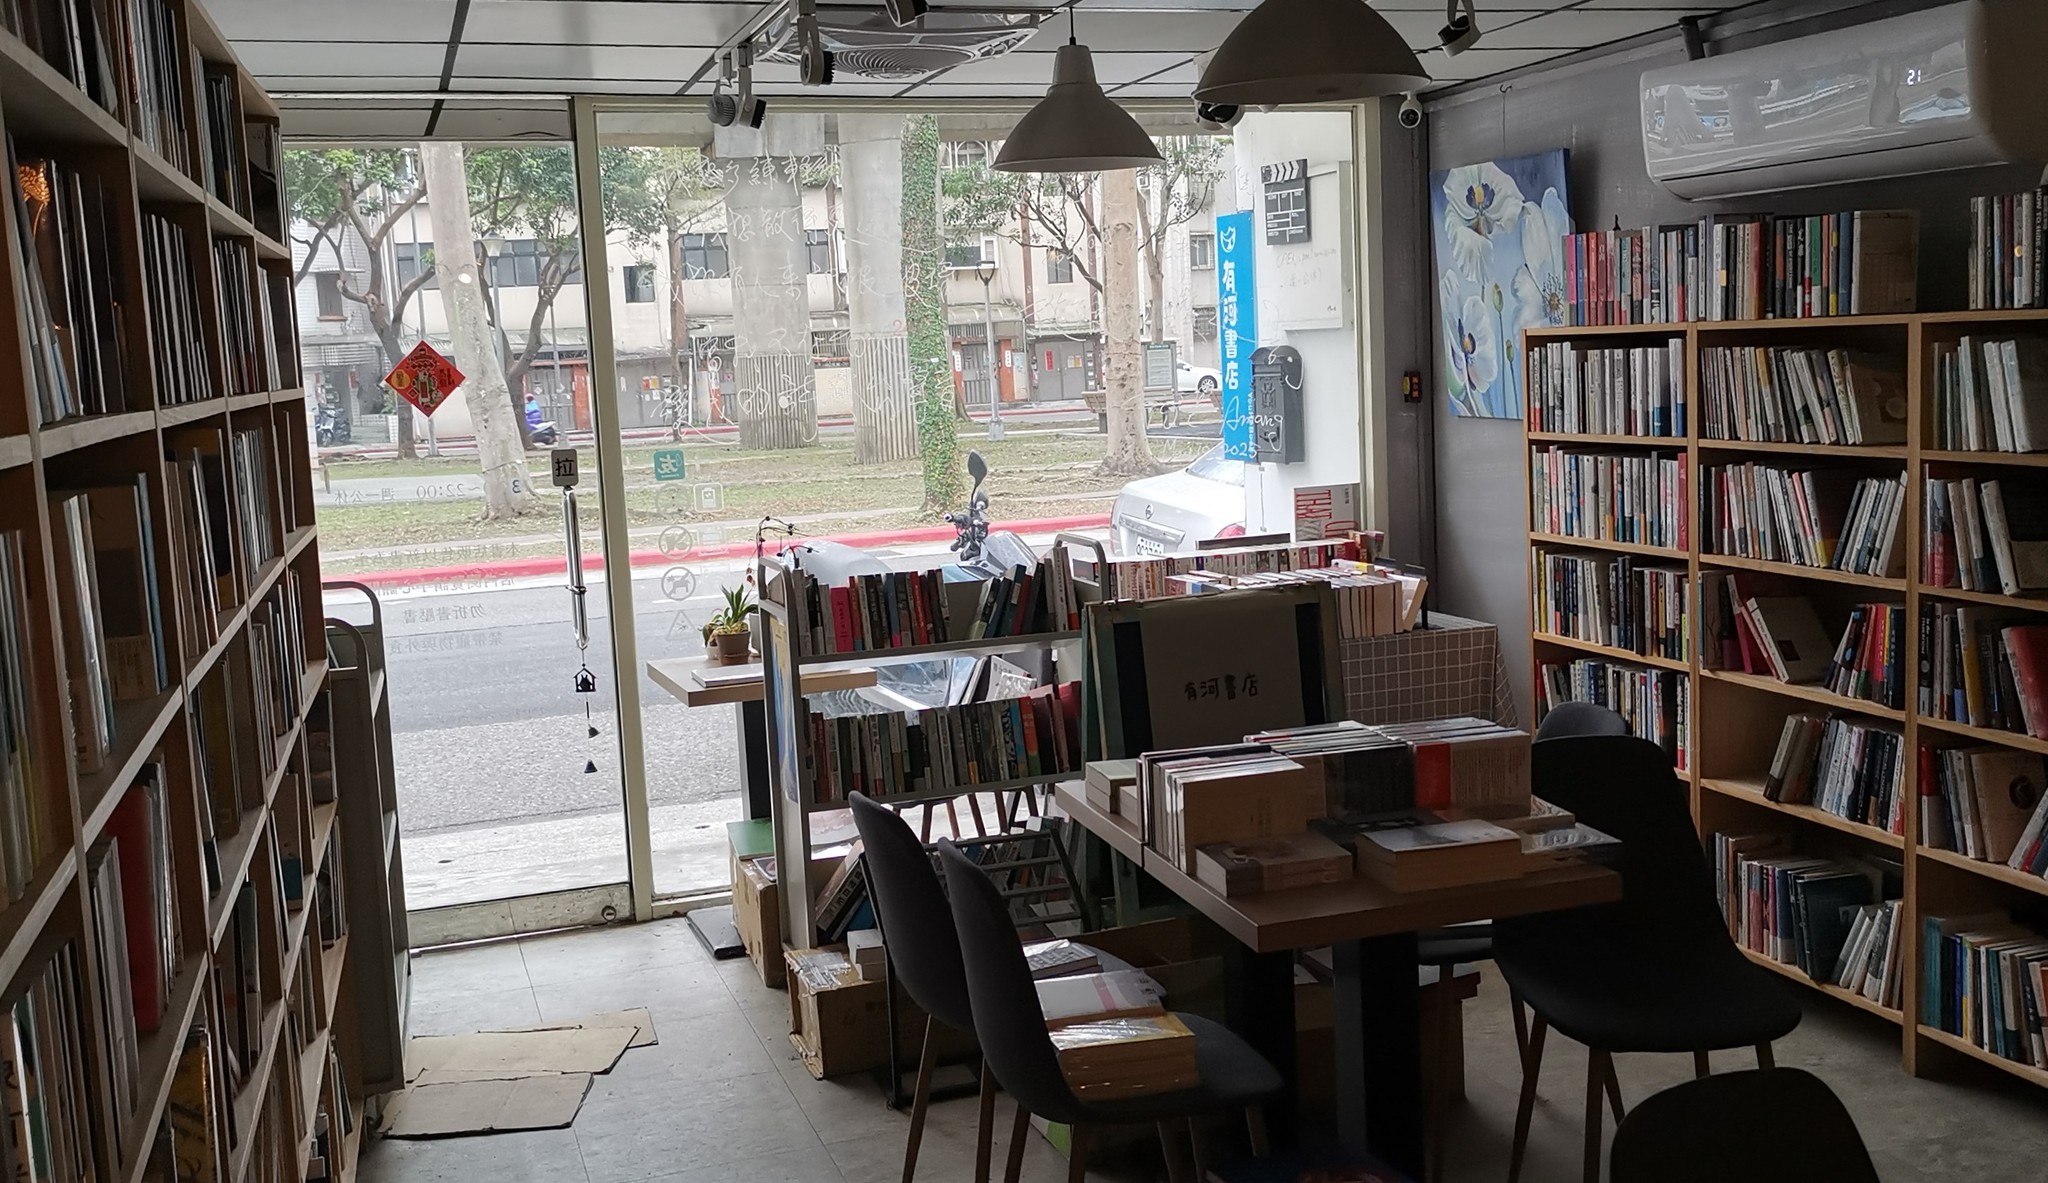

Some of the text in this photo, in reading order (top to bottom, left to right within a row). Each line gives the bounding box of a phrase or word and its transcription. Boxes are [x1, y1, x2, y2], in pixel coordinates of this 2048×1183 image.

[1907, 69, 1921, 85] 21
[1222, 259, 1240, 390] 有河書店
[1219, 395, 1283, 452] Amang
[1222, 442, 1262, 459] 2025
[554, 457, 576, 478] 拉
[1184, 671, 1259, 702] 有河書店
